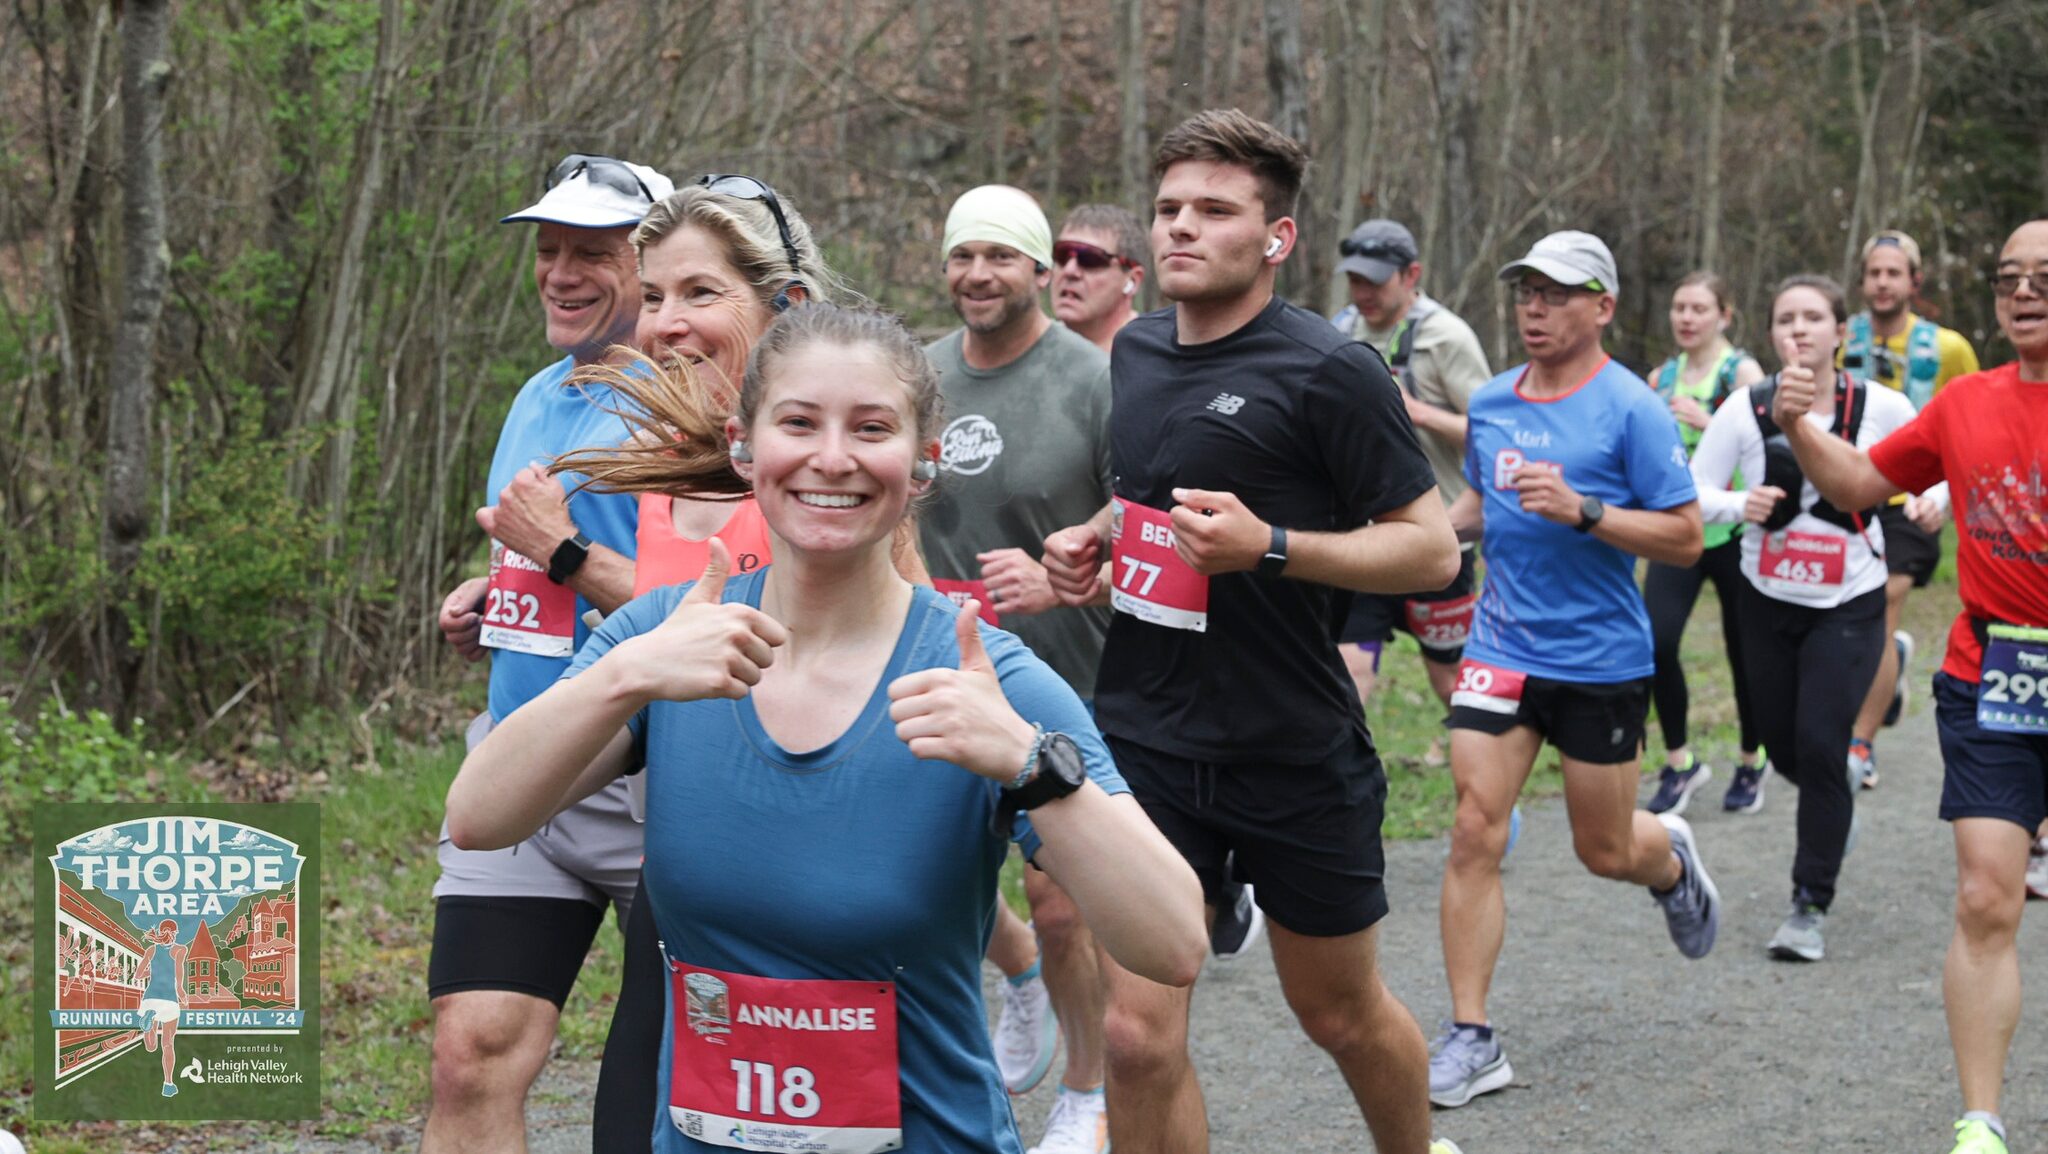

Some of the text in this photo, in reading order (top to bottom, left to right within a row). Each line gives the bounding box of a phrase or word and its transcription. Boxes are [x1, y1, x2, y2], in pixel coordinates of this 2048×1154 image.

[1513, 430, 1552, 449] Mark
[1120, 554, 1162, 596] 77
[1773, 558, 1825, 584] 463
[485, 587, 540, 629] 252
[1424, 622, 1466, 641] 226
[1458, 665, 1493, 693] 30
[737, 1003, 877, 1031] ANNALISE
[730, 1058, 822, 1119] 118
